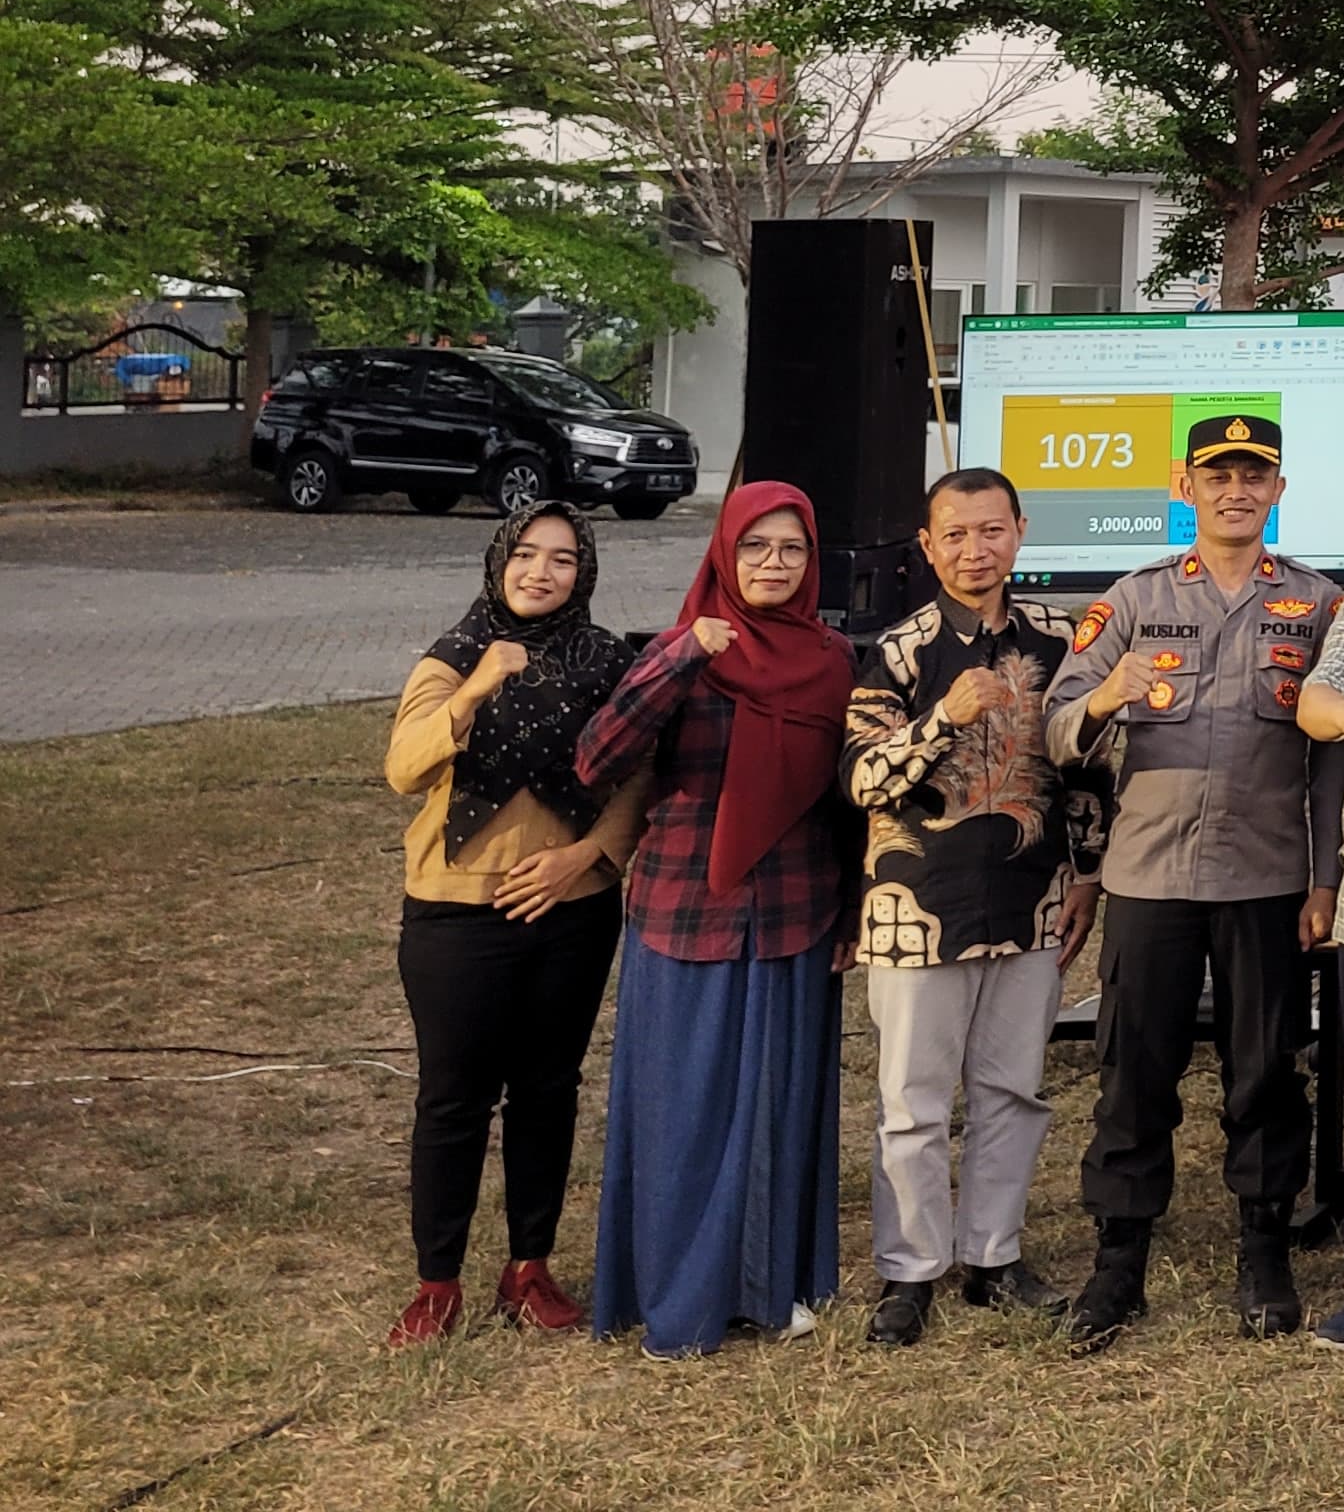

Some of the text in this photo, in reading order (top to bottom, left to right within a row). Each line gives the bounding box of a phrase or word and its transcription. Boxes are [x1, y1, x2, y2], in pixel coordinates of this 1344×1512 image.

[890, 264, 930, 282] ASHLY
[1039, 433, 1134, 469] 1073
[1088, 516, 1163, 535] 3,000,000
[1140, 623, 1313, 638] MUSLICH POLRI
